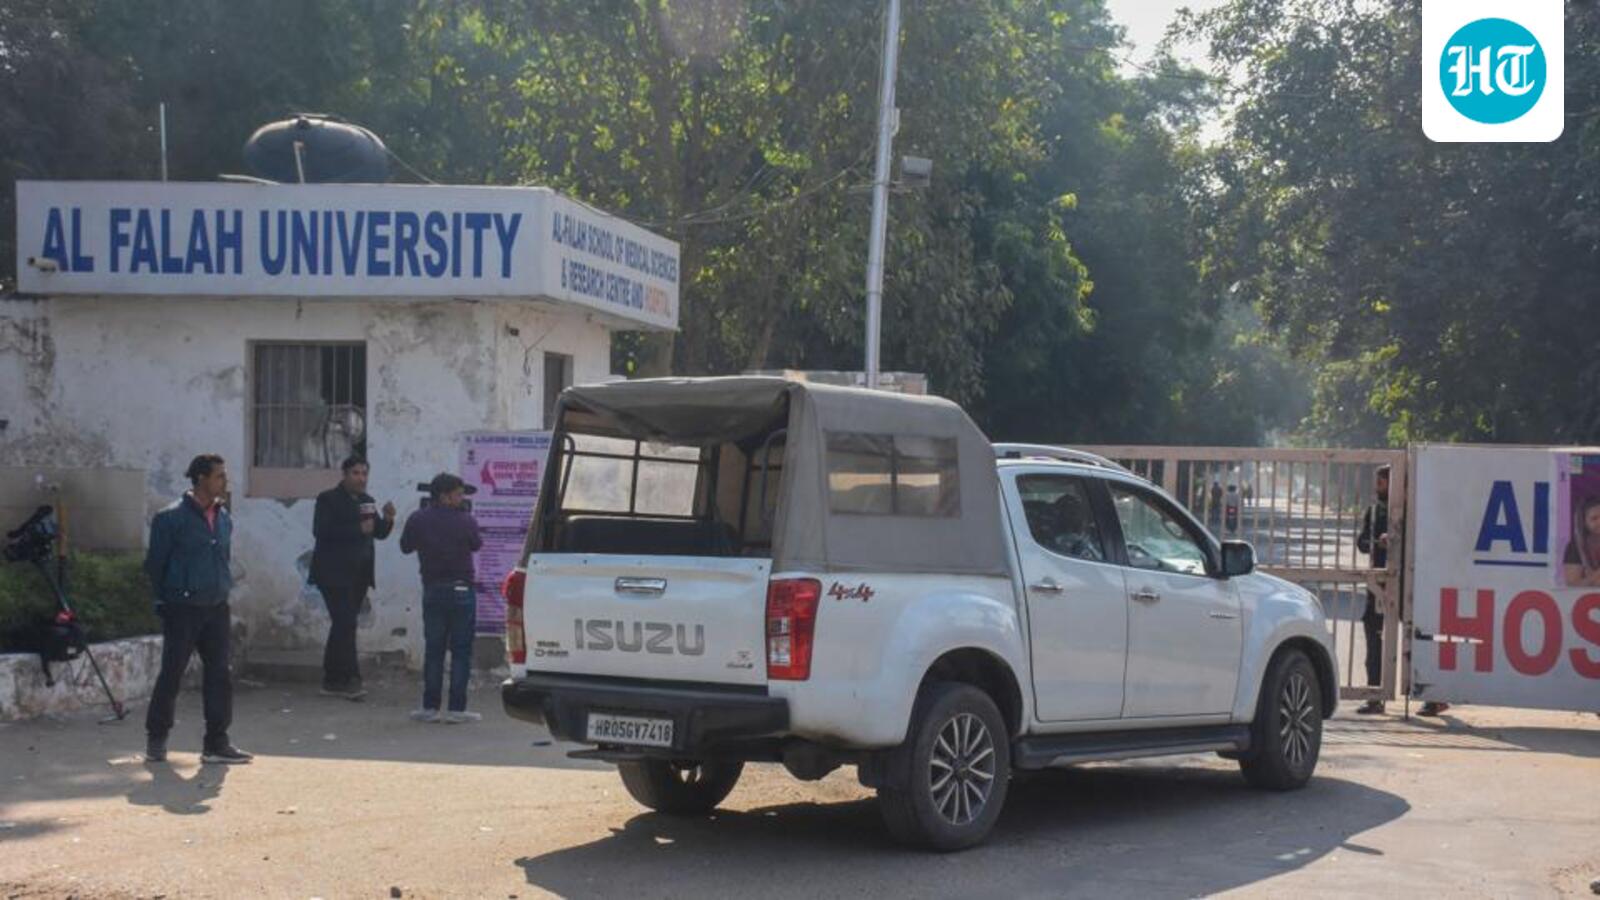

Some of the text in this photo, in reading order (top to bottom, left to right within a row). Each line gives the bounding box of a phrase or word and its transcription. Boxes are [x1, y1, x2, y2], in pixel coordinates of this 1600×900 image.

[42, 207, 523, 279] AL FALAH UNIVERSITY
[588, 222, 614, 262] SCHOOL
[615, 234, 624, 264] OF
[569, 260, 604, 300] RESEARCH
[606, 271, 630, 308] CENTRE
[631, 281, 643, 311] AND
[574, 618, 706, 656] ISUZU
